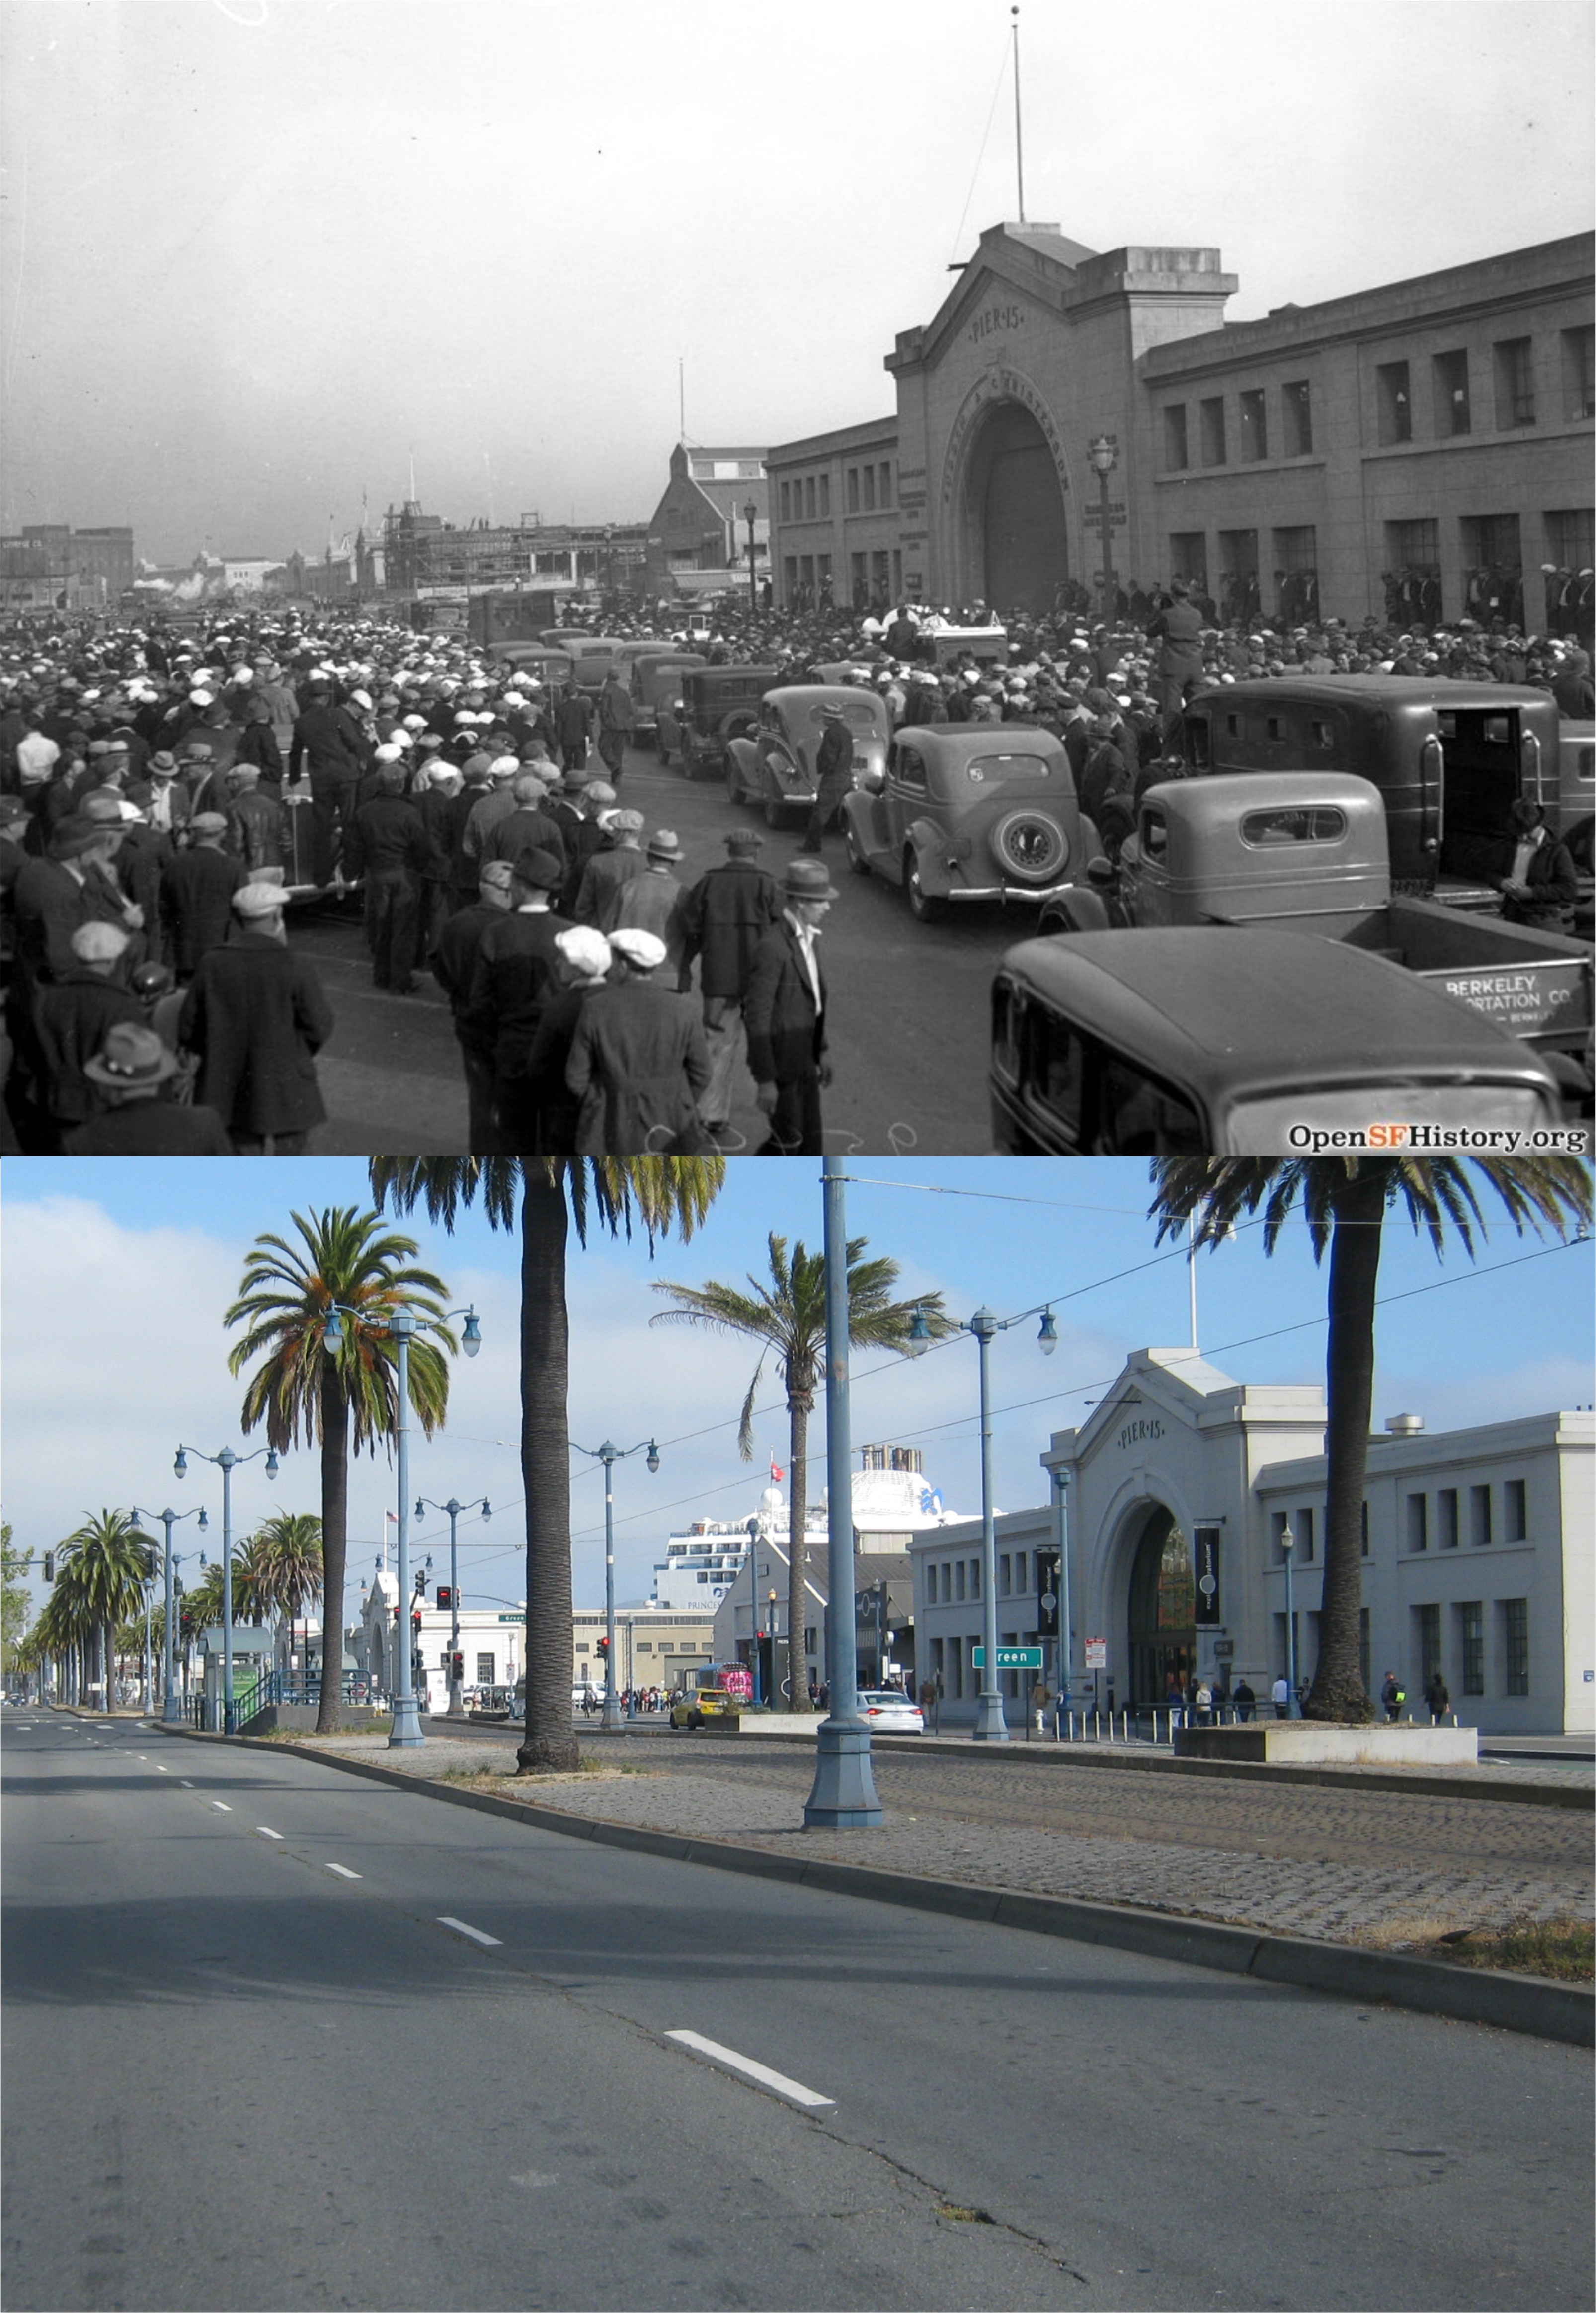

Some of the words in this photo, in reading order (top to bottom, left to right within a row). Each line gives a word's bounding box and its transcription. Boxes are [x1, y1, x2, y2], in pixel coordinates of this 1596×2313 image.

[1446, 975, 1536, 996] BERKELEY
[1465, 992, 1541, 1012] ORTATION
[688, 1601, 720, 1610] PRINCES
[997, 1652, 1027, 1662] reen
